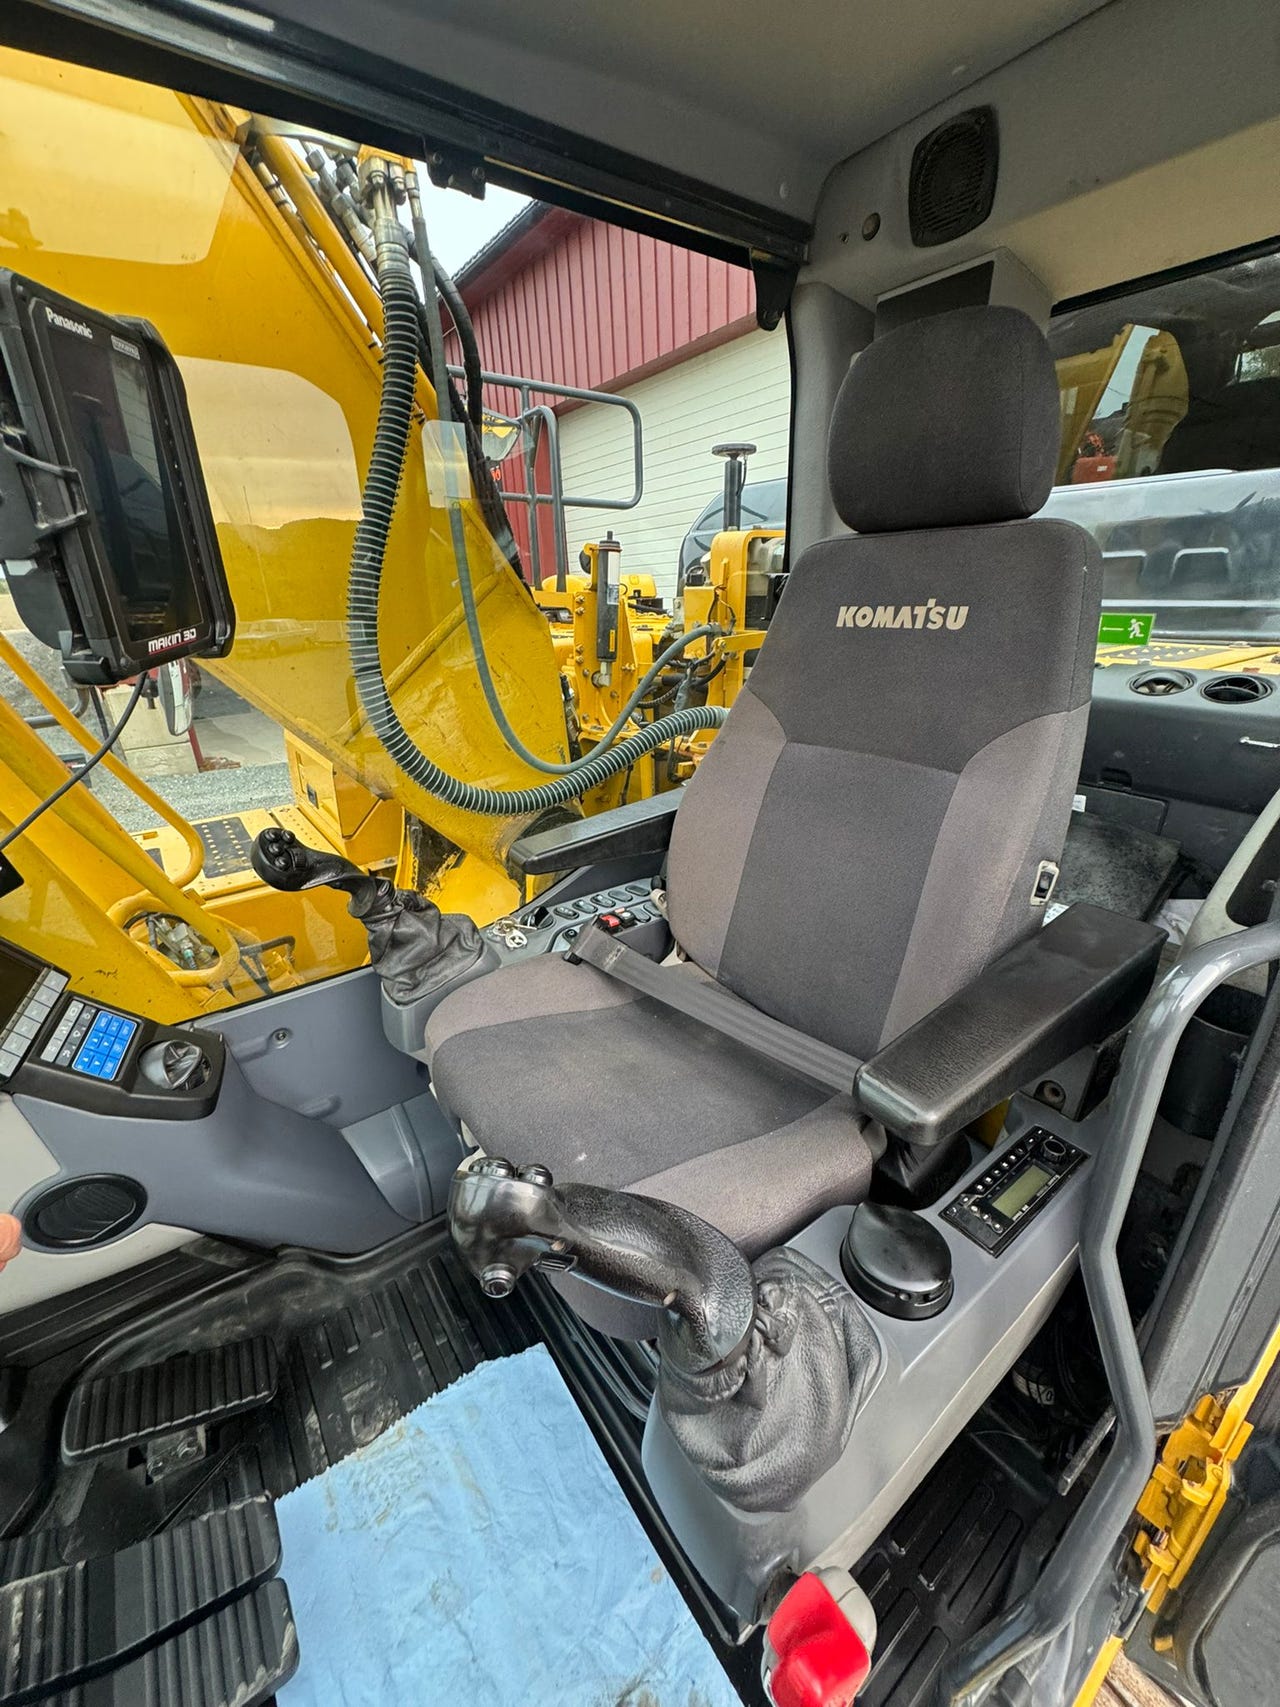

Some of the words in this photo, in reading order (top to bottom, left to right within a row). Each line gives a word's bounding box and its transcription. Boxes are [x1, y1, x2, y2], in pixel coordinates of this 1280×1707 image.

[45, 306, 93, 339] Panasonic
[836, 598, 969, 631] KOMATSU
[148, 632, 182, 653] MAKIN
[183, 628, 197, 641] 3D
